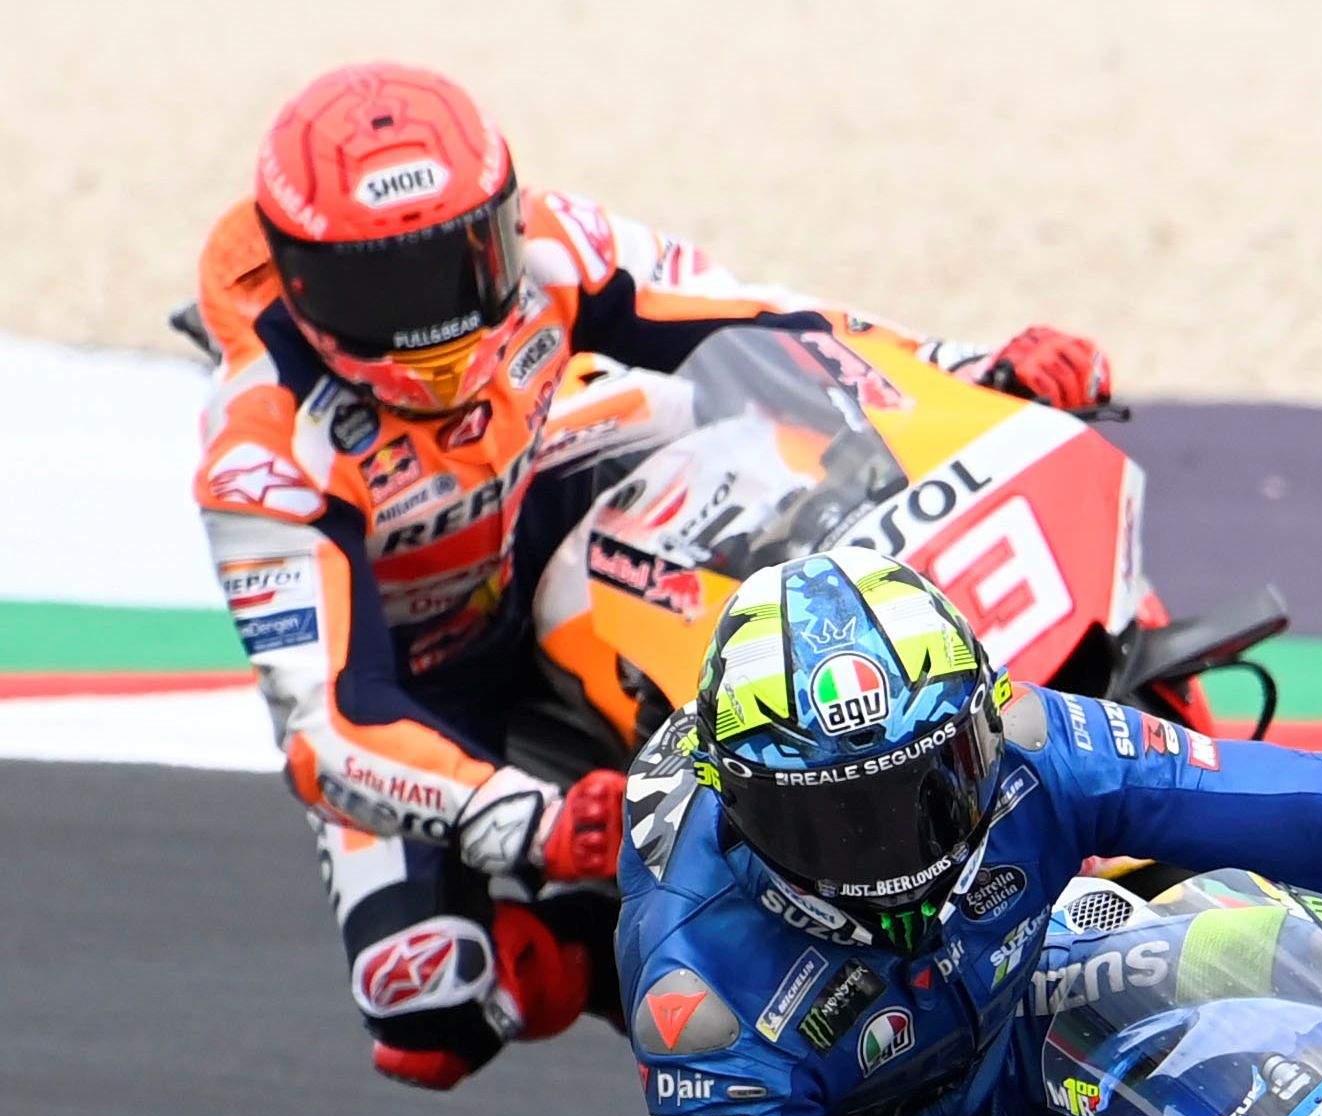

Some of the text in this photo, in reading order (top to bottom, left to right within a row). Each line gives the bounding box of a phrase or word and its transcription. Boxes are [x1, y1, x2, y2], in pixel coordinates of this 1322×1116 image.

[367, 168, 434, 200] SHOEI
[394, 310, 481, 348] PULL&BEAR
[828, 692, 882, 730] agv
[790, 723, 957, 787] REALE SEGUROS
[839, 883, 870, 897] JUST
[876, 873, 912, 896] BEER
[911, 856, 952, 886] LOVERS
[966, 871, 1016, 907] Estrella
[973, 884, 1019, 915] Galicia
[777, 960, 816, 1013] MICHELIN
